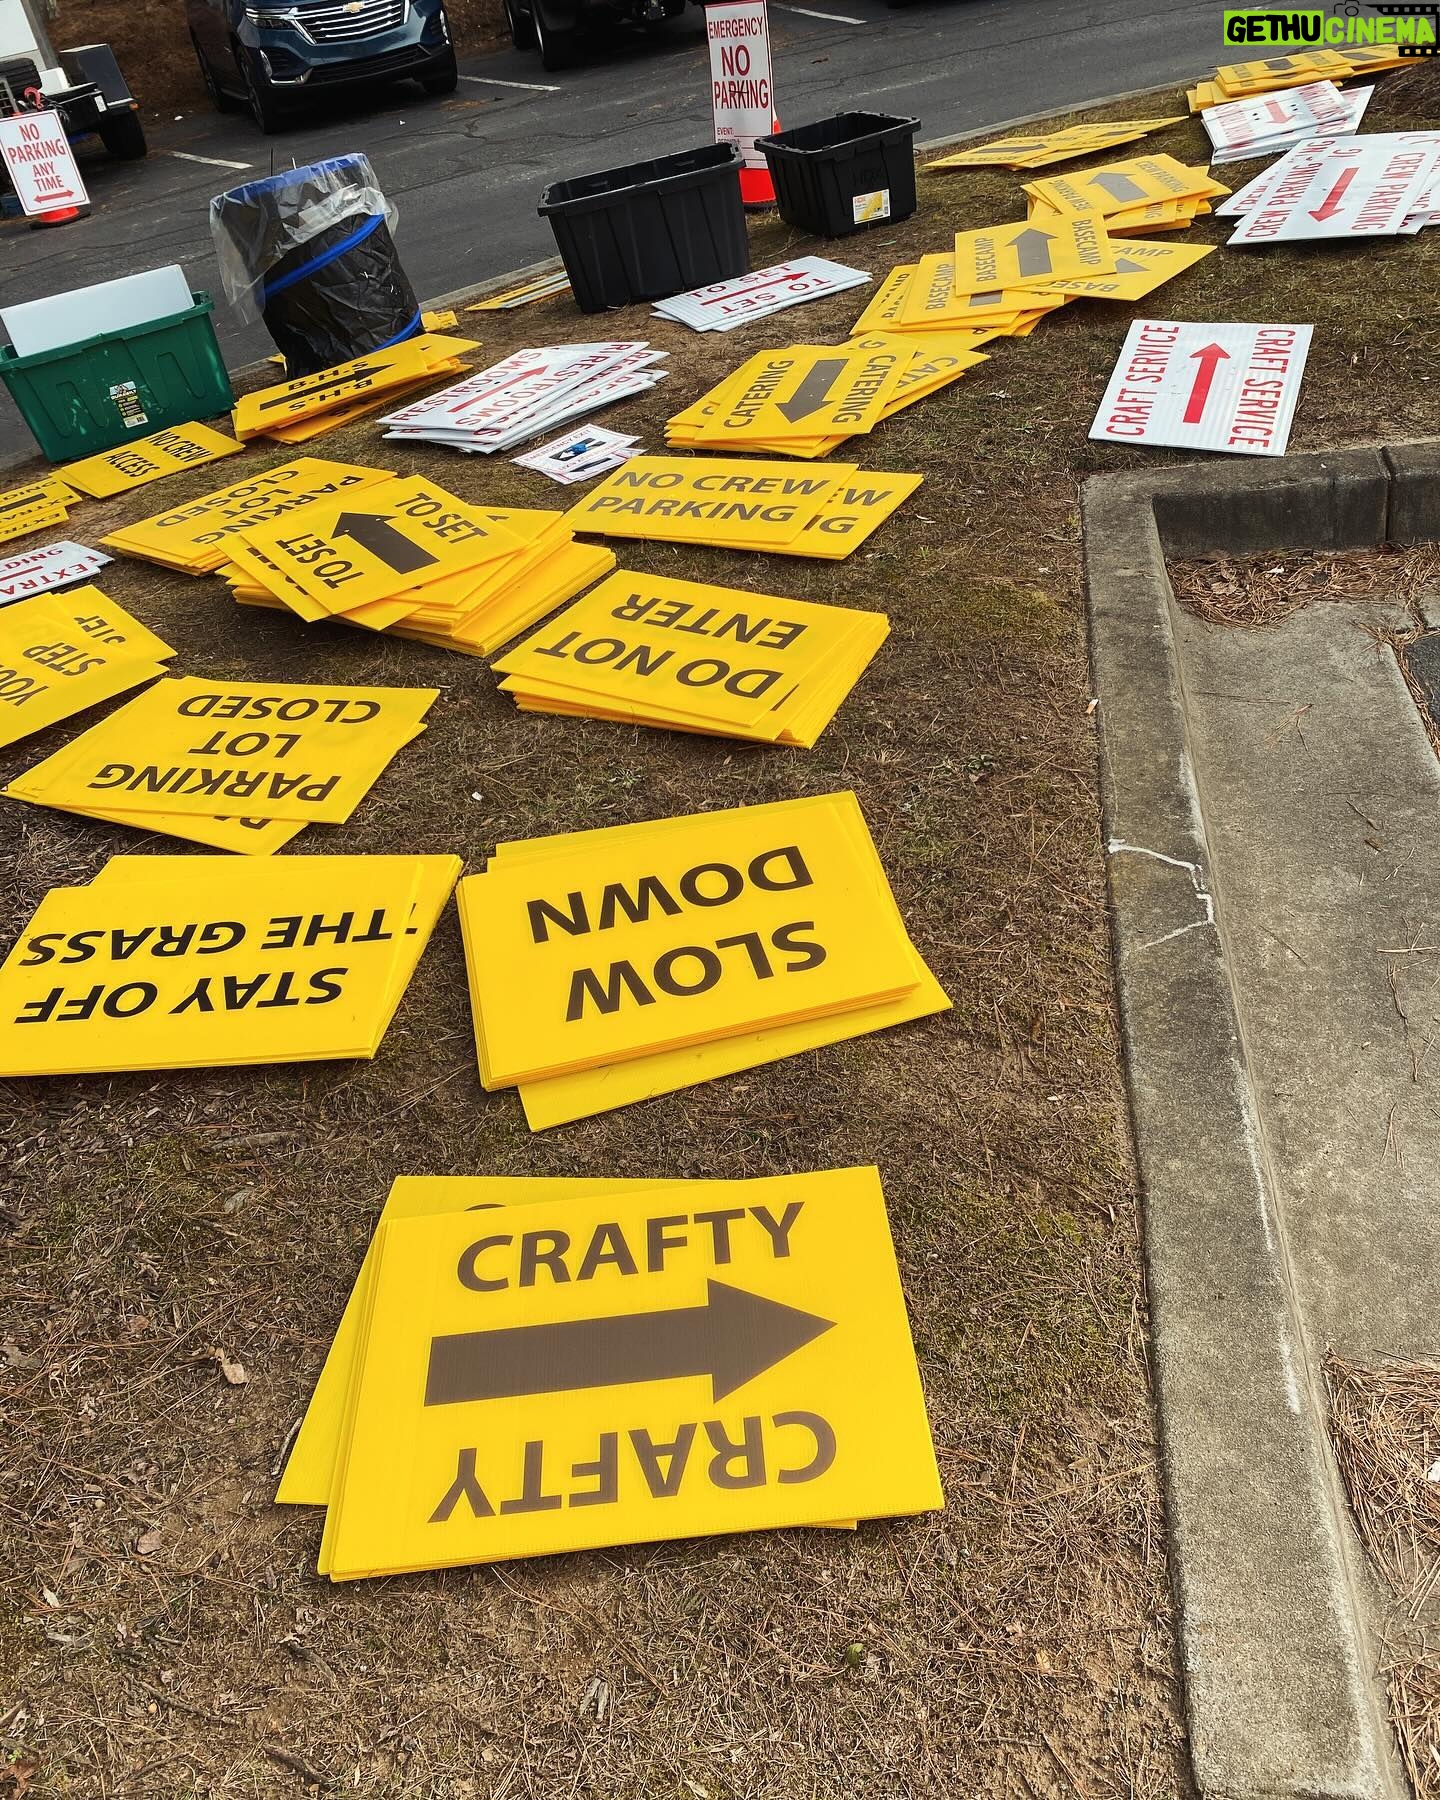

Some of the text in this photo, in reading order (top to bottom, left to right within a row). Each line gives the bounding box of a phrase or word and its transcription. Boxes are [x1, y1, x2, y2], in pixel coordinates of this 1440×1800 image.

[708, 17, 763, 39] EMERGENCY
[721, 45, 750, 76] NO
[714, 79, 768, 109] PARKING
[19, 123, 40, 142] NO
[8, 139, 66, 164] PARKING
[1380, 152, 1426, 180] CREW
[32, 161, 55, 178] ANY
[33, 175, 64, 192] TIME
[1266, 162, 1323, 207] PARKING
[1245, 210, 1292, 238] CREW
[1351, 184, 1408, 231] PARKING
[1072, 219, 1101, 265] BASECAMP
[975, 238, 997, 282] BASECAMP
[686, 265, 792, 298] TO SET
[722, 278, 831, 314] TO SET
[390, 352, 543, 422] RESTROOMS
[456, 355, 610, 426] RESTROOMS
[724, 359, 795, 428] CATERING
[832, 355, 896, 424] CATERING
[1106, 325, 1180, 436] CRAFT SERVICE
[1228, 330, 1296, 448] CRAFT SERVICE
[103, 451, 160, 477] ACCESS
[146, 432, 214, 462] NO CREW
[0, 481, 57, 500] DING
[156, 470, 299, 527] CLOSED
[612, 471, 830, 496] NO CREW
[192, 476, 364, 544] PARKING
[221, 489, 292, 519] LOT
[394, 492, 488, 544] TO SET
[588, 496, 798, 522] PARKING
[0, 549, 63, 572] DING
[275, 533, 337, 564] SET
[0, 564, 88, 595] EXTRA
[313, 560, 364, 589] TO
[610, 593, 808, 650] ENTER
[22, 642, 106, 676] STEP
[533, 631, 784, 700] DO NOT
[177, 694, 382, 724] CLOSED
[189, 730, 302, 759] LOT
[87, 763, 342, 802] PARKING
[526, 845, 814, 944] DOWN
[18, 908, 393, 966] THE GRASS
[565, 921, 827, 1022] SLOW
[14, 967, 350, 1024] STAY OFF
[457, 1202, 805, 1292] CRAFTY
[427, 1410, 838, 1524] CRAFTY
